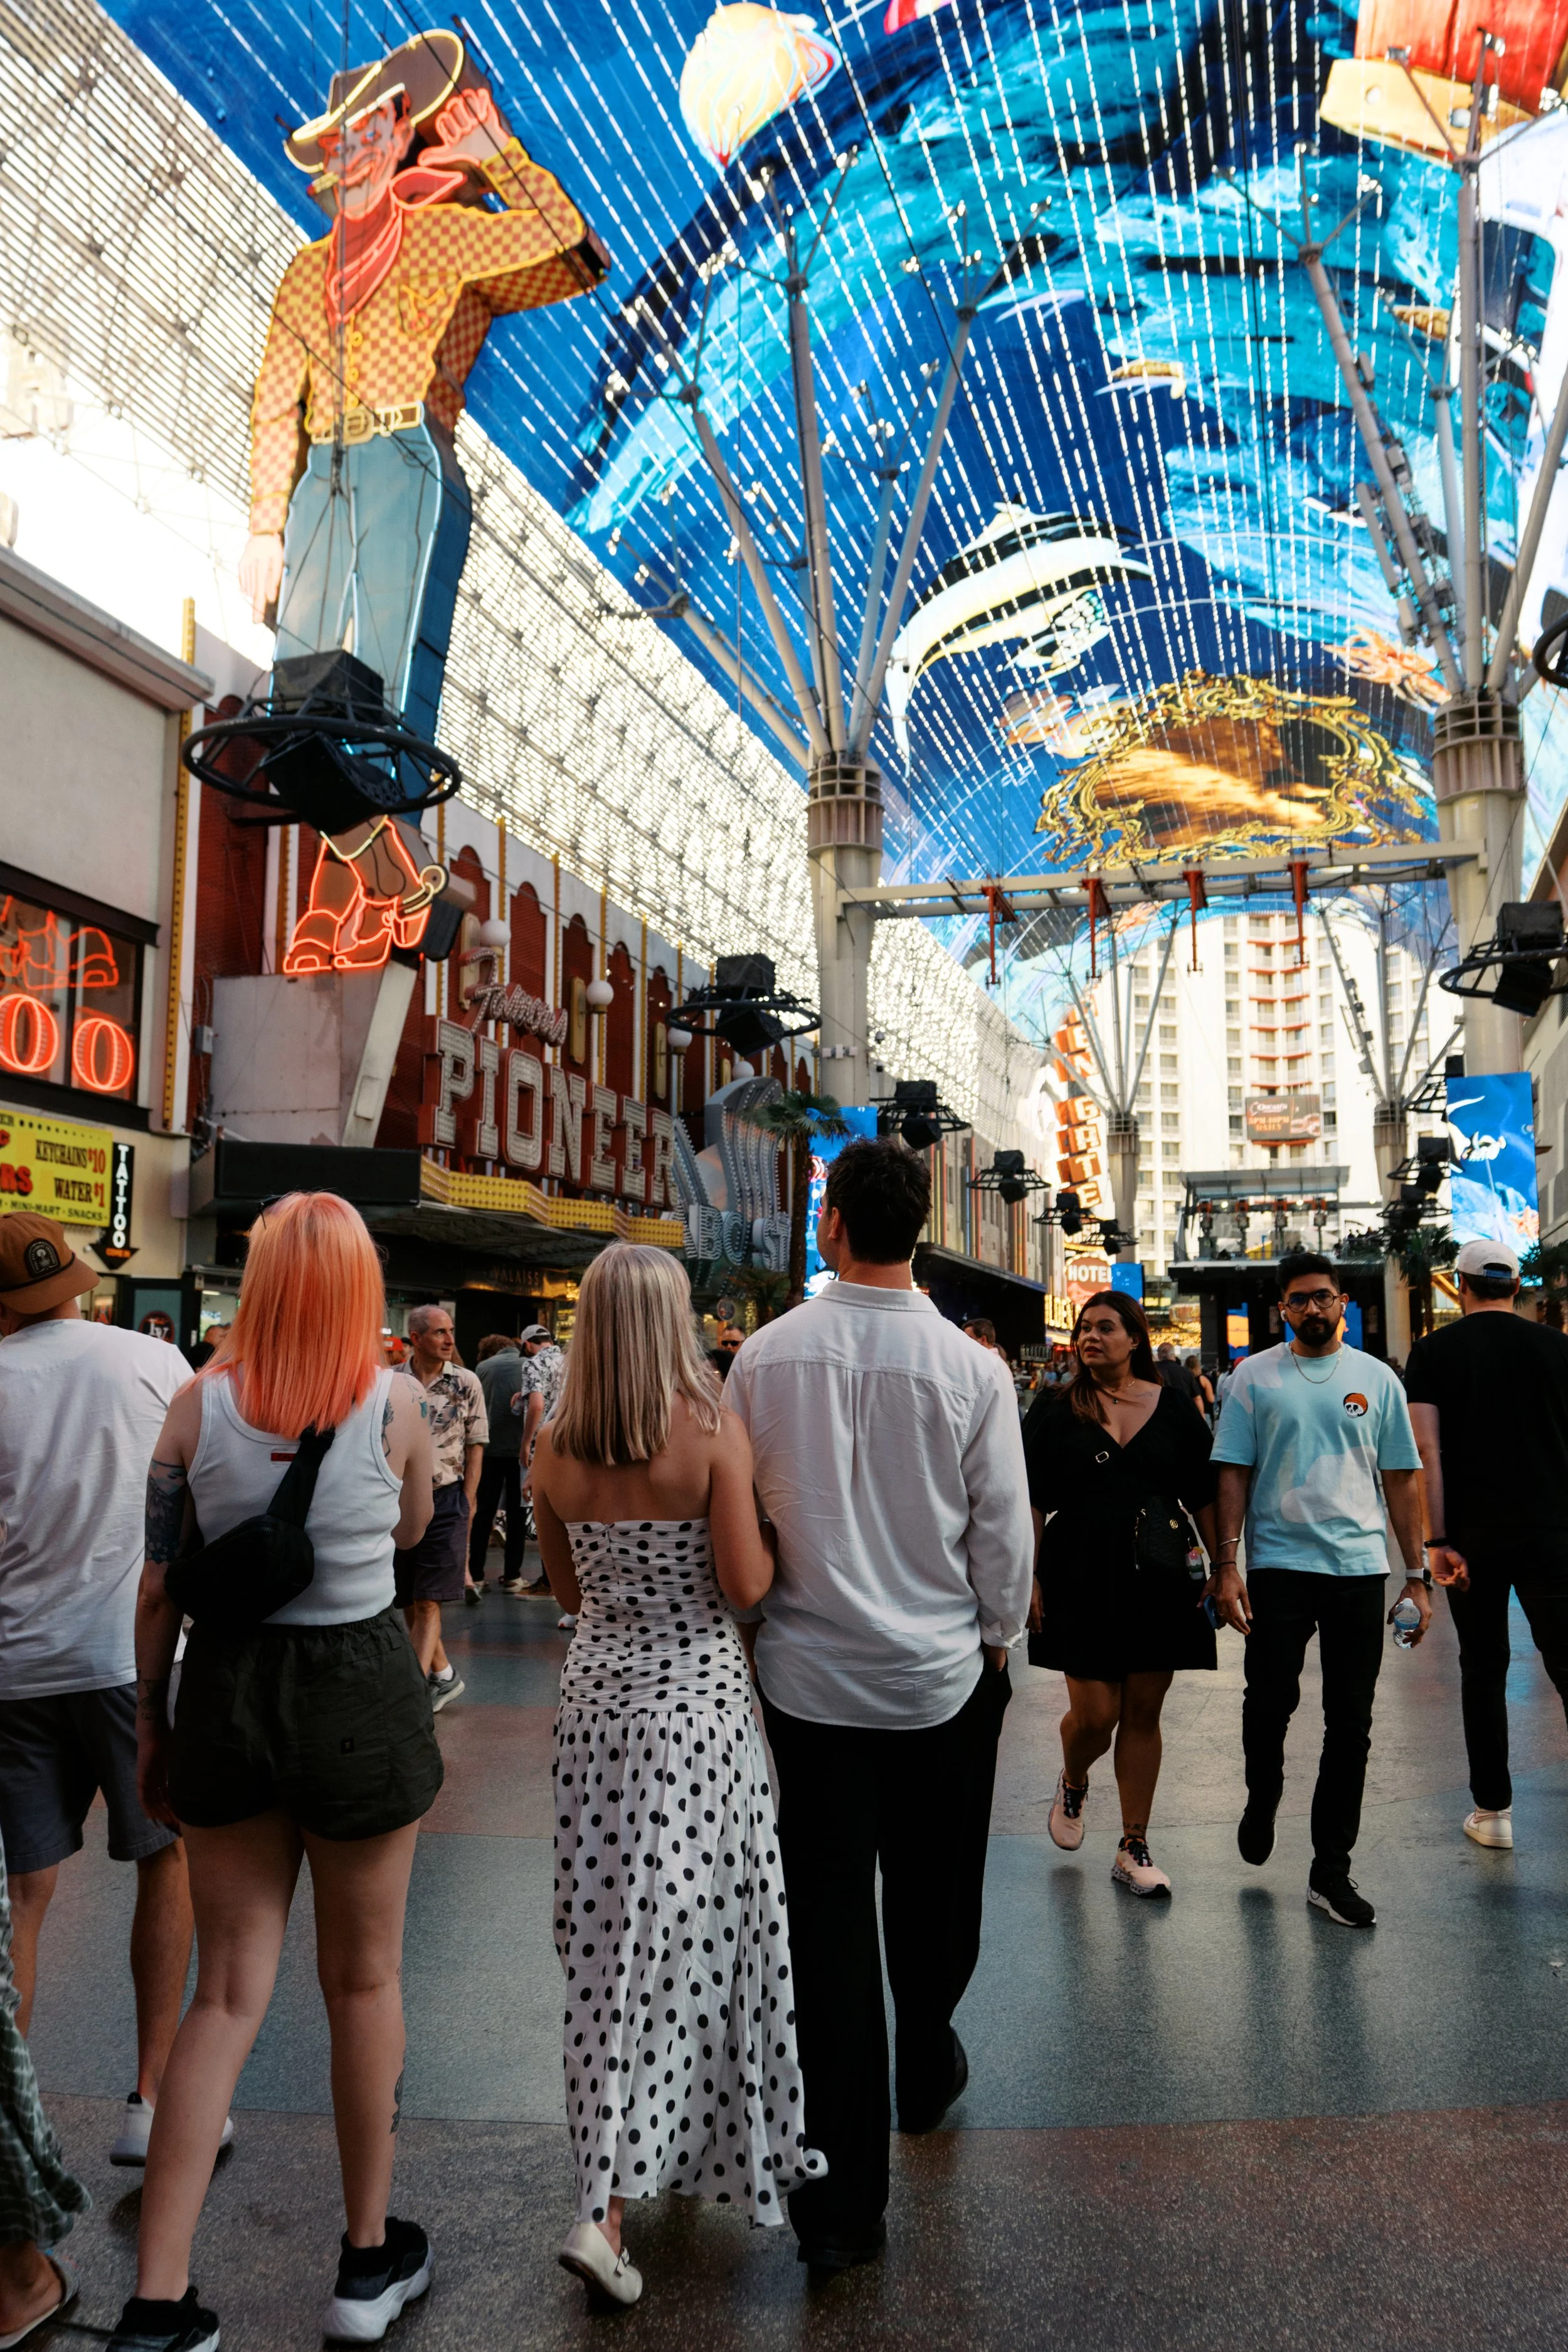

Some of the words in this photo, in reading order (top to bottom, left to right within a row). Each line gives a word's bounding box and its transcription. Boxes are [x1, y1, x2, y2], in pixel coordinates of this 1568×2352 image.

[432, 1017, 679, 1210] PIONEER
[36, 1139, 87, 1169] KEYCHAINS
[87, 1147, 106, 1174] $10
[1074, 1095, 1101, 1209] GATE
[54, 1177, 92, 1203] WATER
[94, 1182, 105, 1208] $1
[68, 1207, 103, 1221] SNACKS
[112, 1144, 129, 1248] TATTOO
